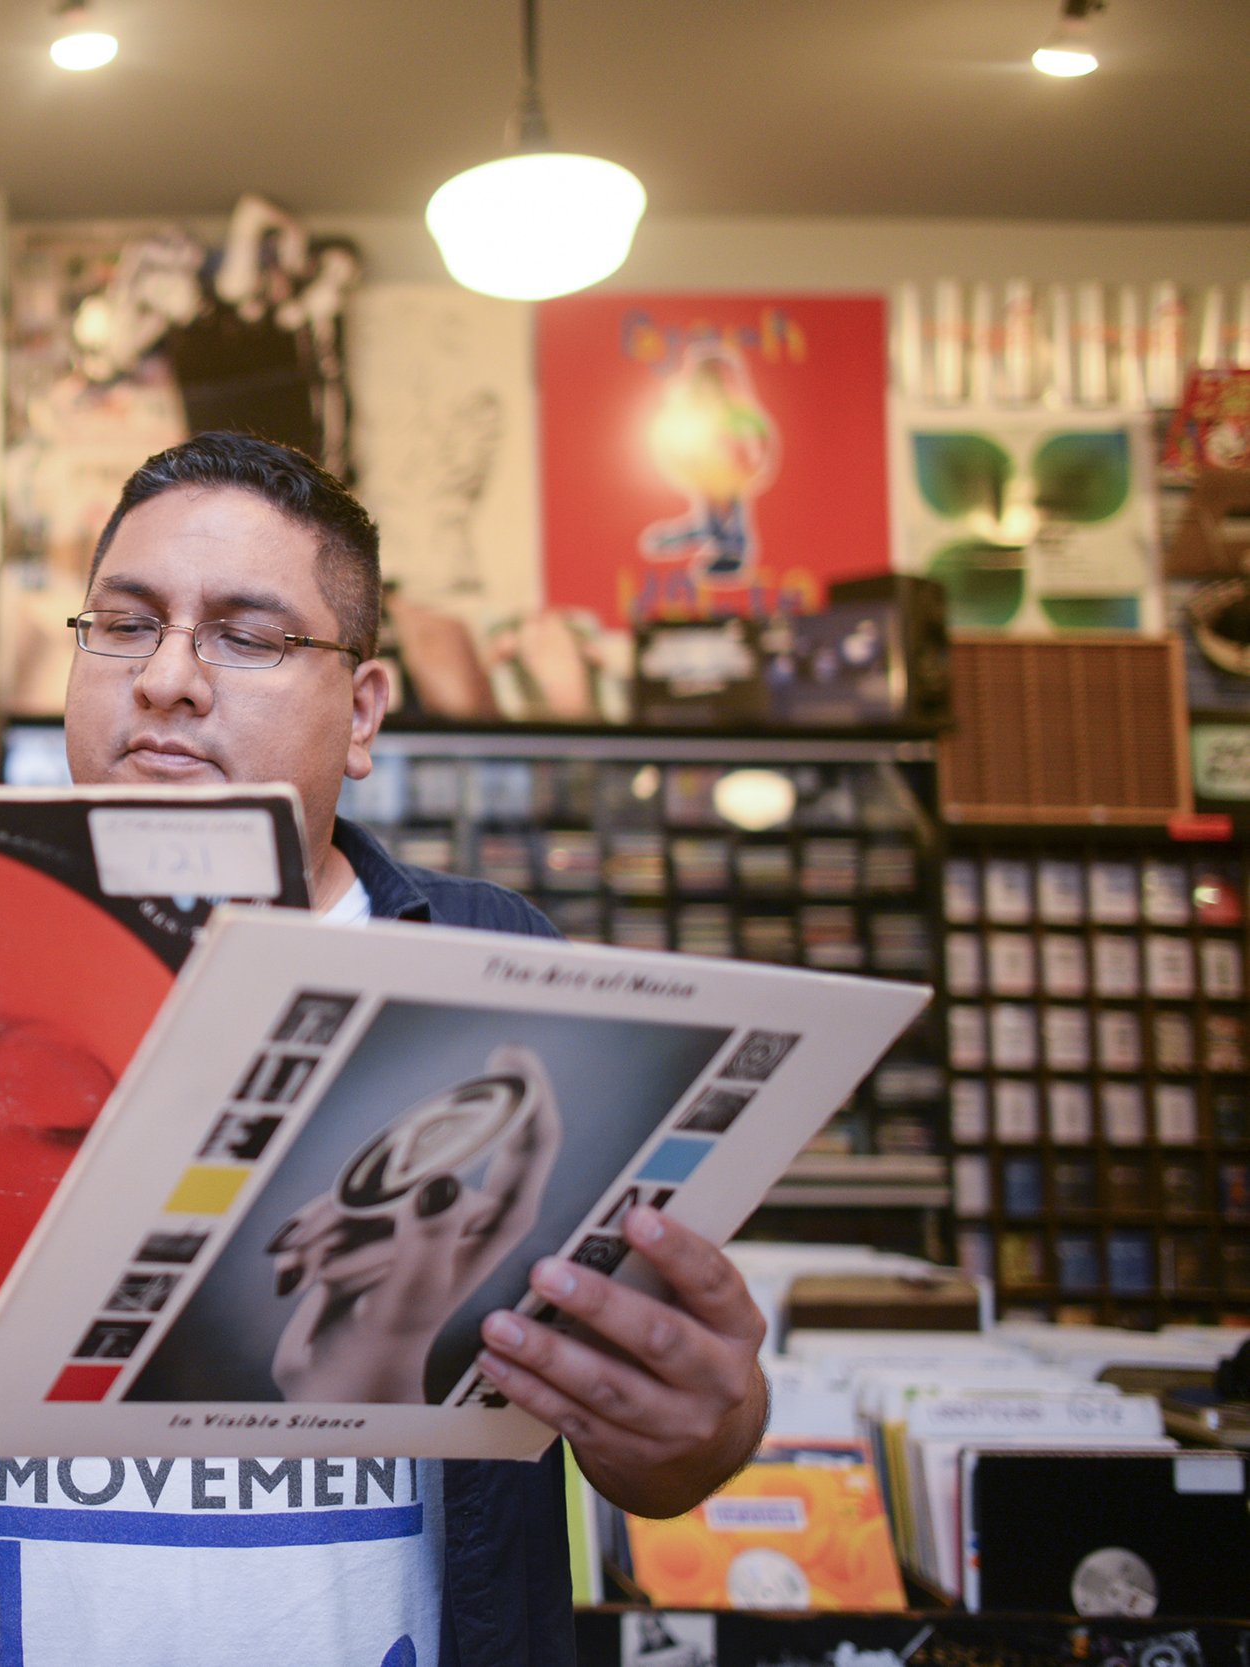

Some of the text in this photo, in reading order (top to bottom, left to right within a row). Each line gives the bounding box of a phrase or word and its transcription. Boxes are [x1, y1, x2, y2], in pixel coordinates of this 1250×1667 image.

[483, 954, 698, 999] The Art of Noise
[168, 1413, 367, 1429] In Visible Silence
